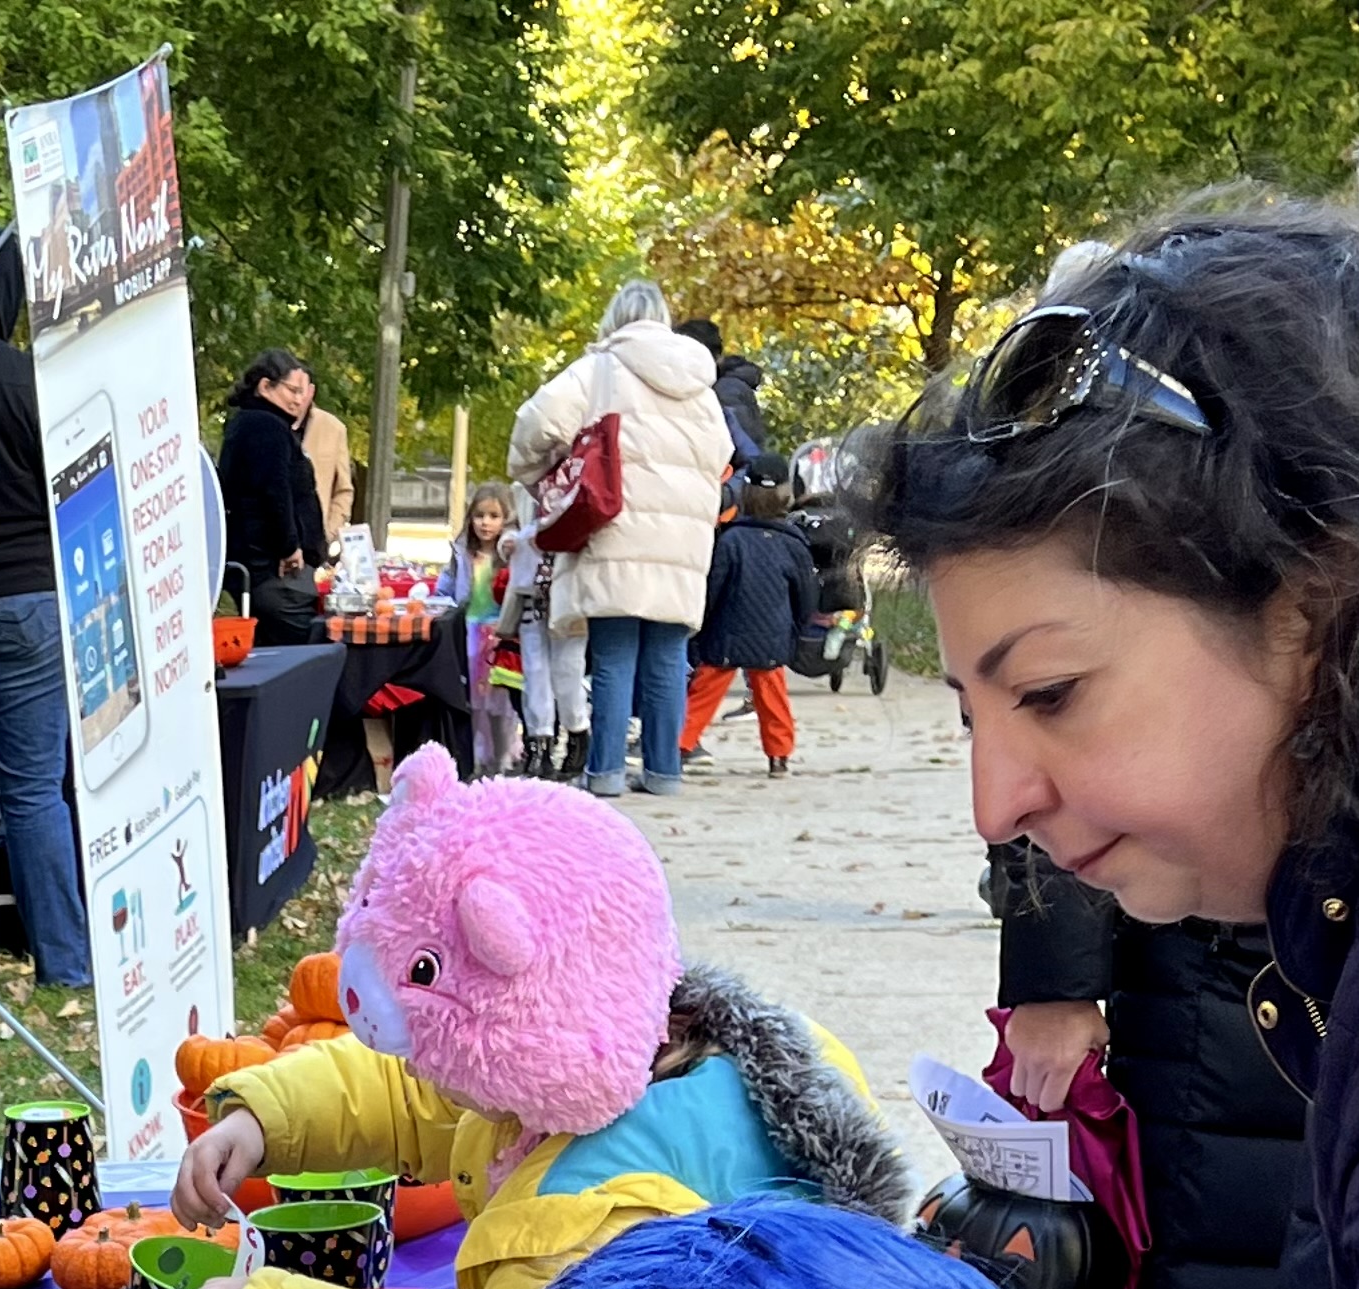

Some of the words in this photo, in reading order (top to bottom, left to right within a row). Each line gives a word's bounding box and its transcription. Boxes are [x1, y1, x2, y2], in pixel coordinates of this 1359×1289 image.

[27, 239, 63, 320] My
[65, 224, 118, 284] River
[120, 180, 170, 263] North
[114, 267, 153, 306] MOBILE
[154, 257, 172, 284] APP
[138, 398, 169, 439] YOUR
[133, 474, 186, 536] RESOURCE
[143, 535, 166, 573] FOR
[167, 521, 183, 557] ALL
[147, 563, 184, 614] THINGS
[155, 609, 184, 653] RIVER
[154, 646, 190, 698] NORTH
[88, 826, 118, 868] FREE
